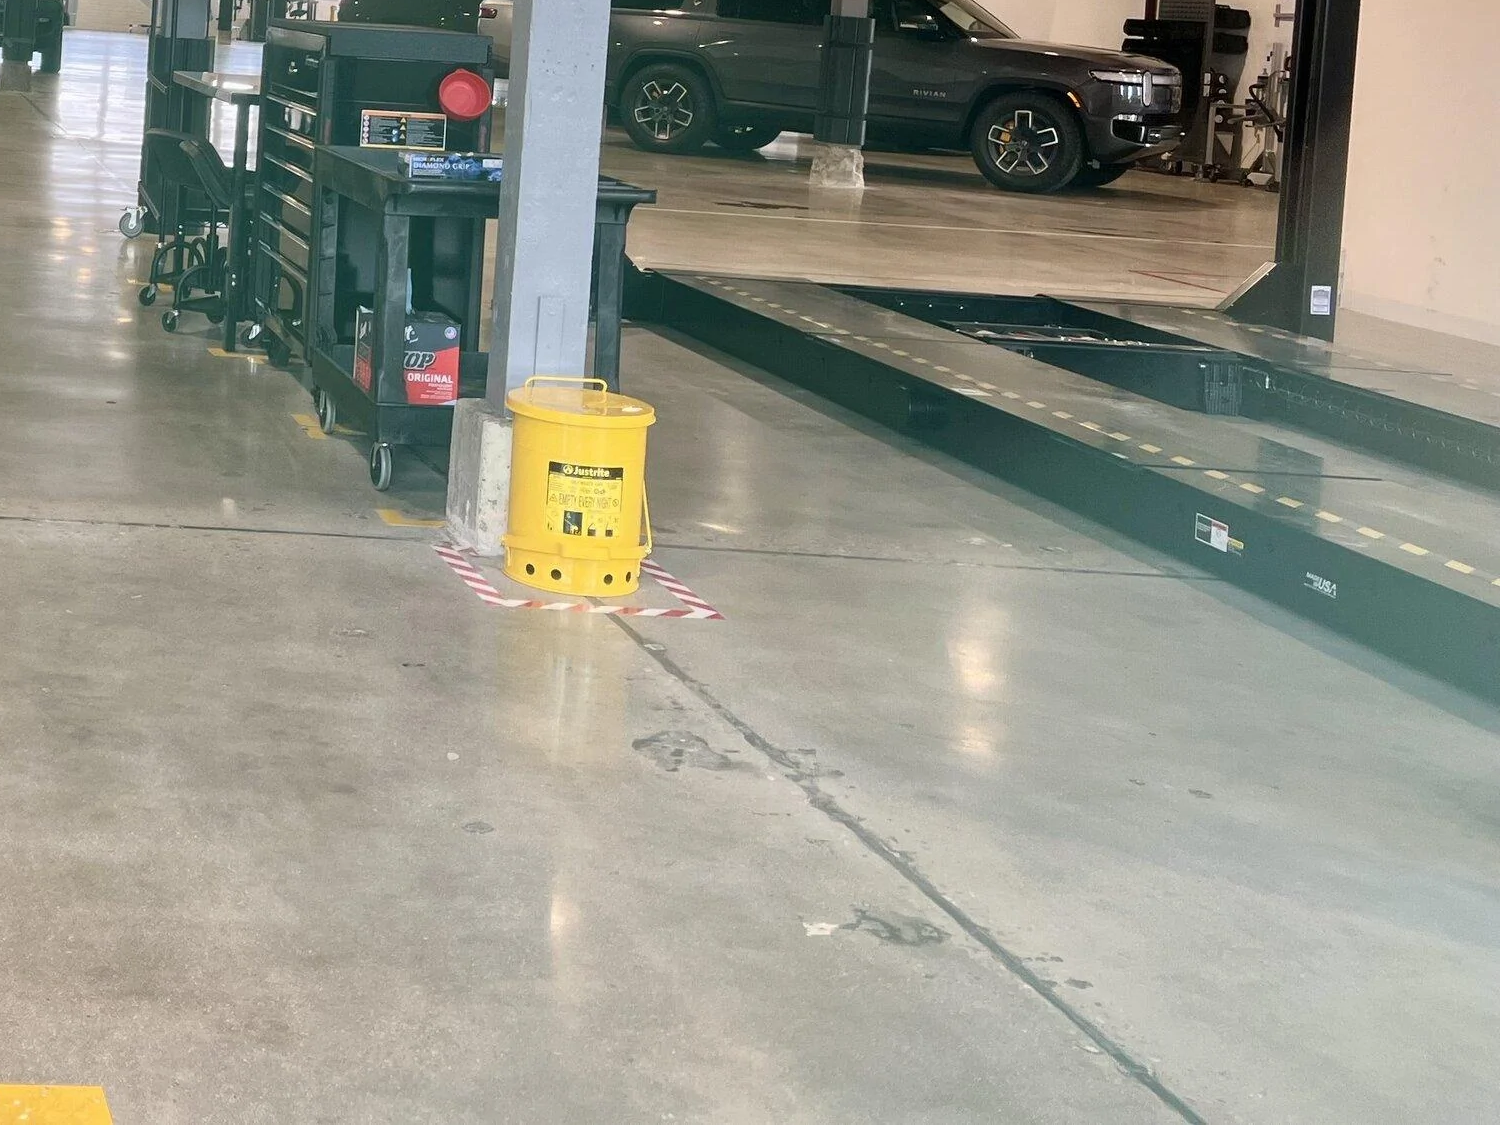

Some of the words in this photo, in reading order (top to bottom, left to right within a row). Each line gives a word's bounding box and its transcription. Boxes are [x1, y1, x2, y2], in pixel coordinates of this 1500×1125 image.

[913, 89, 946, 98] RIVIAN
[413, 162, 451, 170] DIAMOND
[407, 372, 454, 384] ORIGINAL
[573, 466, 610, 477] Justrite
[1318, 577, 1336, 595] USA
